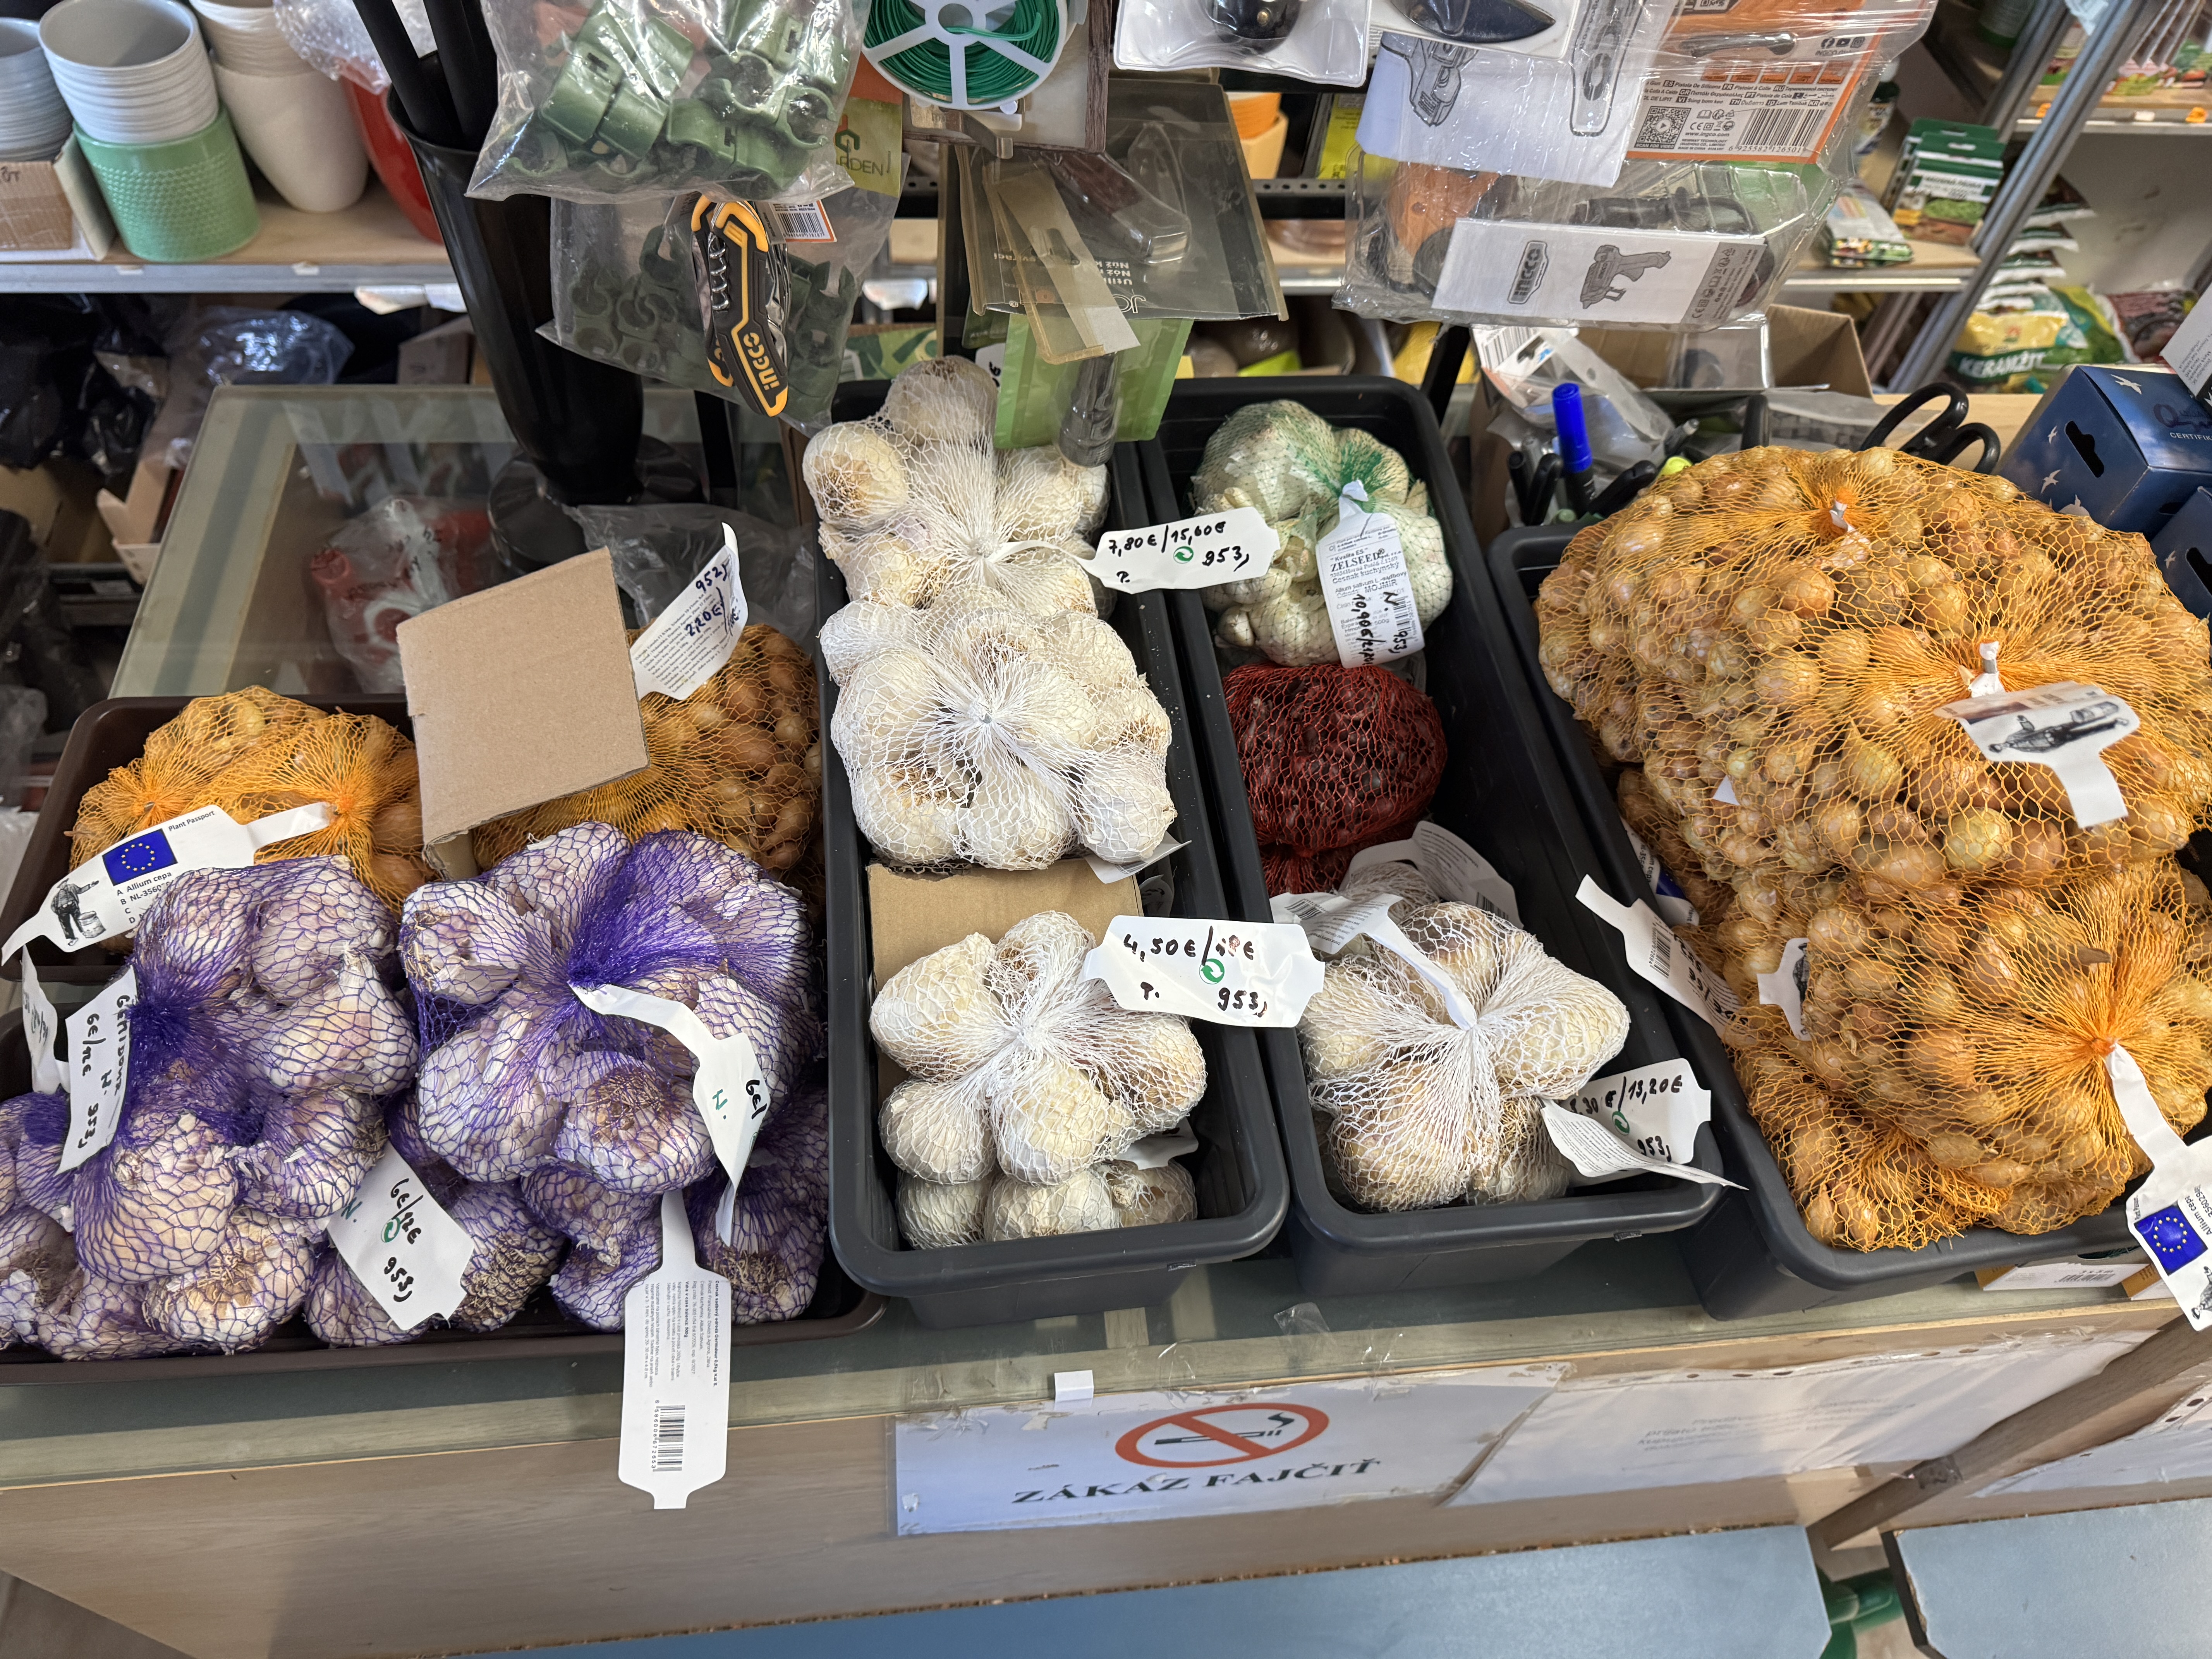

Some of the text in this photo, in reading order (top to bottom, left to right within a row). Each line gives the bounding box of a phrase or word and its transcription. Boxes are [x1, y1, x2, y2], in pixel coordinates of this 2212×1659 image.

[836, 156, 884, 176] RDEN
[1331, 551, 1380, 572] ZELSEED
[1360, 562, 1398, 576] kuchynský
[168, 811, 214, 831] Plant Passport
[127, 879, 151, 892] Allium
[153, 872, 171, 881] cepa
[1012, 1458, 1382, 1504] ZÁKAZ FAJČIŤ
